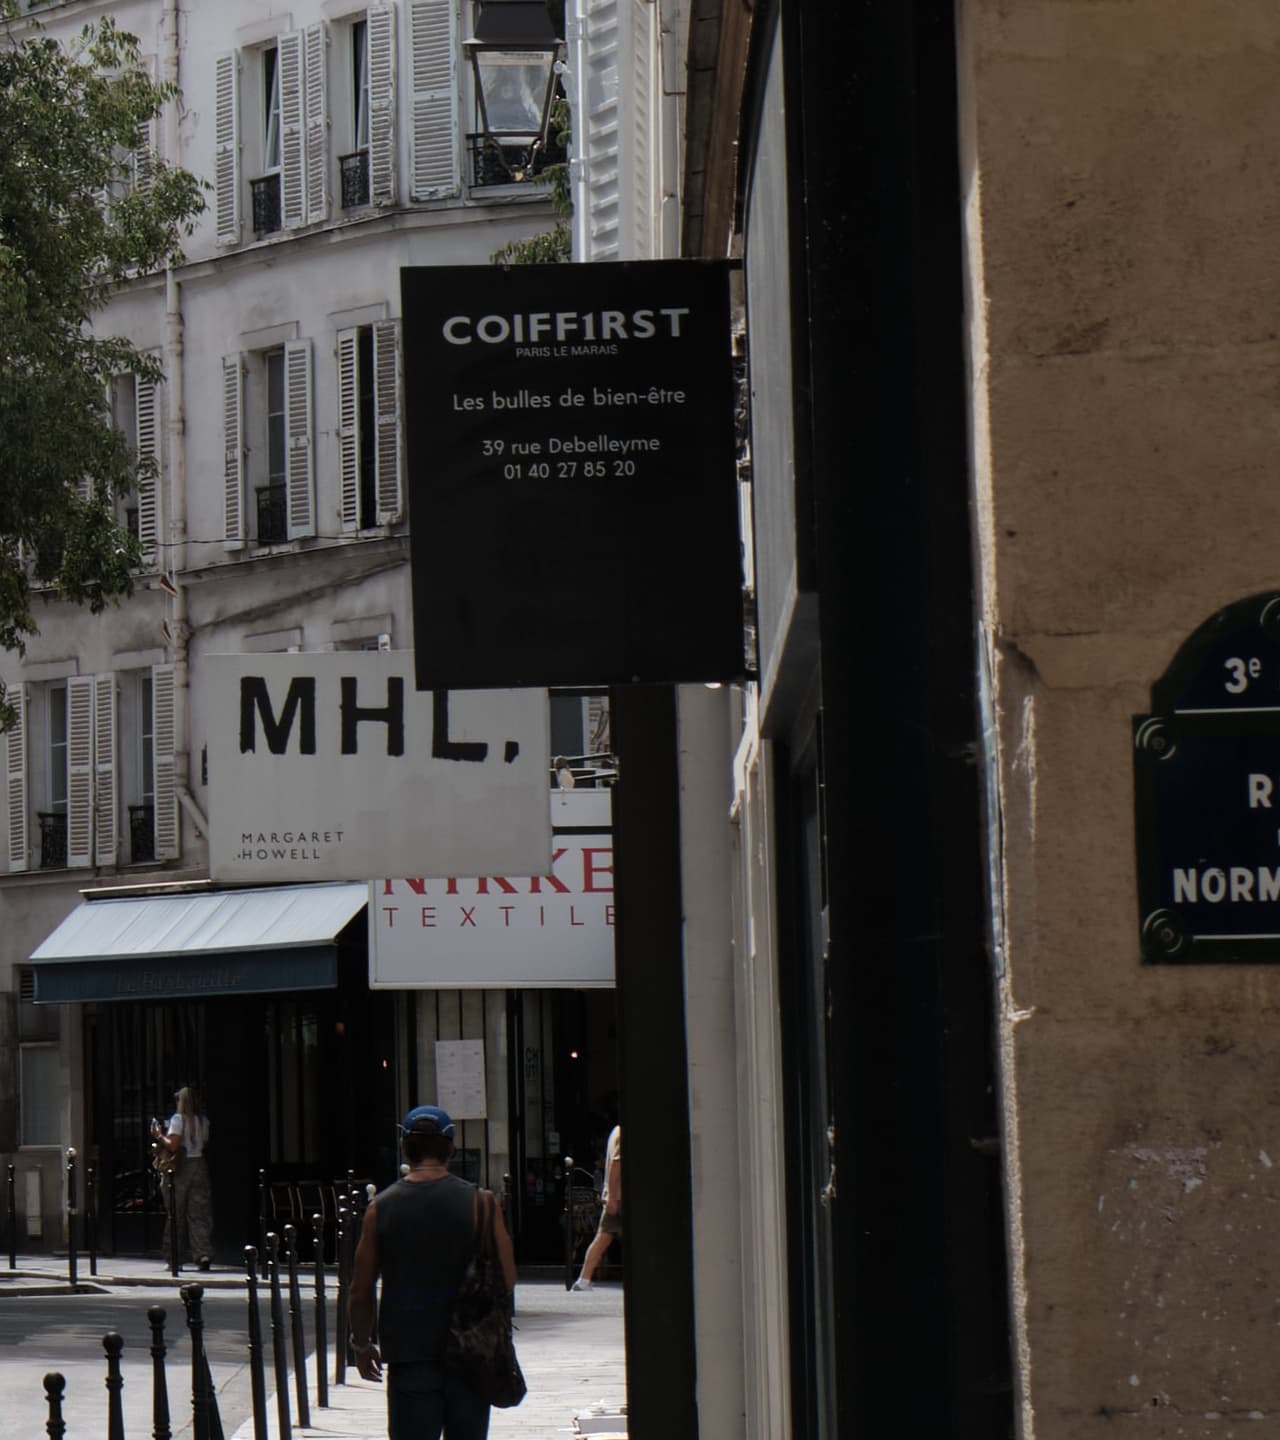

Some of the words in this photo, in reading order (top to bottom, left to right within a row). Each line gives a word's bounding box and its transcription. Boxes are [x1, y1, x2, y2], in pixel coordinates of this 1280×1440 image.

[516, 346, 551, 359] PARIS
[553, 345, 568, 357] LE
[571, 344, 619, 357] MARAIS
[453, 393, 484, 411] Les
[492, 389, 552, 410] bulles
[559, 387, 585, 407] de
[593, 386, 686, 406] bien-être
[482, 439, 505, 457] 39
[511, 441, 541, 456] rue
[548, 434, 661, 457] Debelleyme
[504, 464, 522, 480] 01
[528, 463, 550, 479] 40
[557, 462, 577, 478] 27
[583, 461, 606, 477] 85
[615, 460, 636, 477] 20
[241, 831, 344, 844] MARGARET
[241, 848, 321, 860] HOWELL
